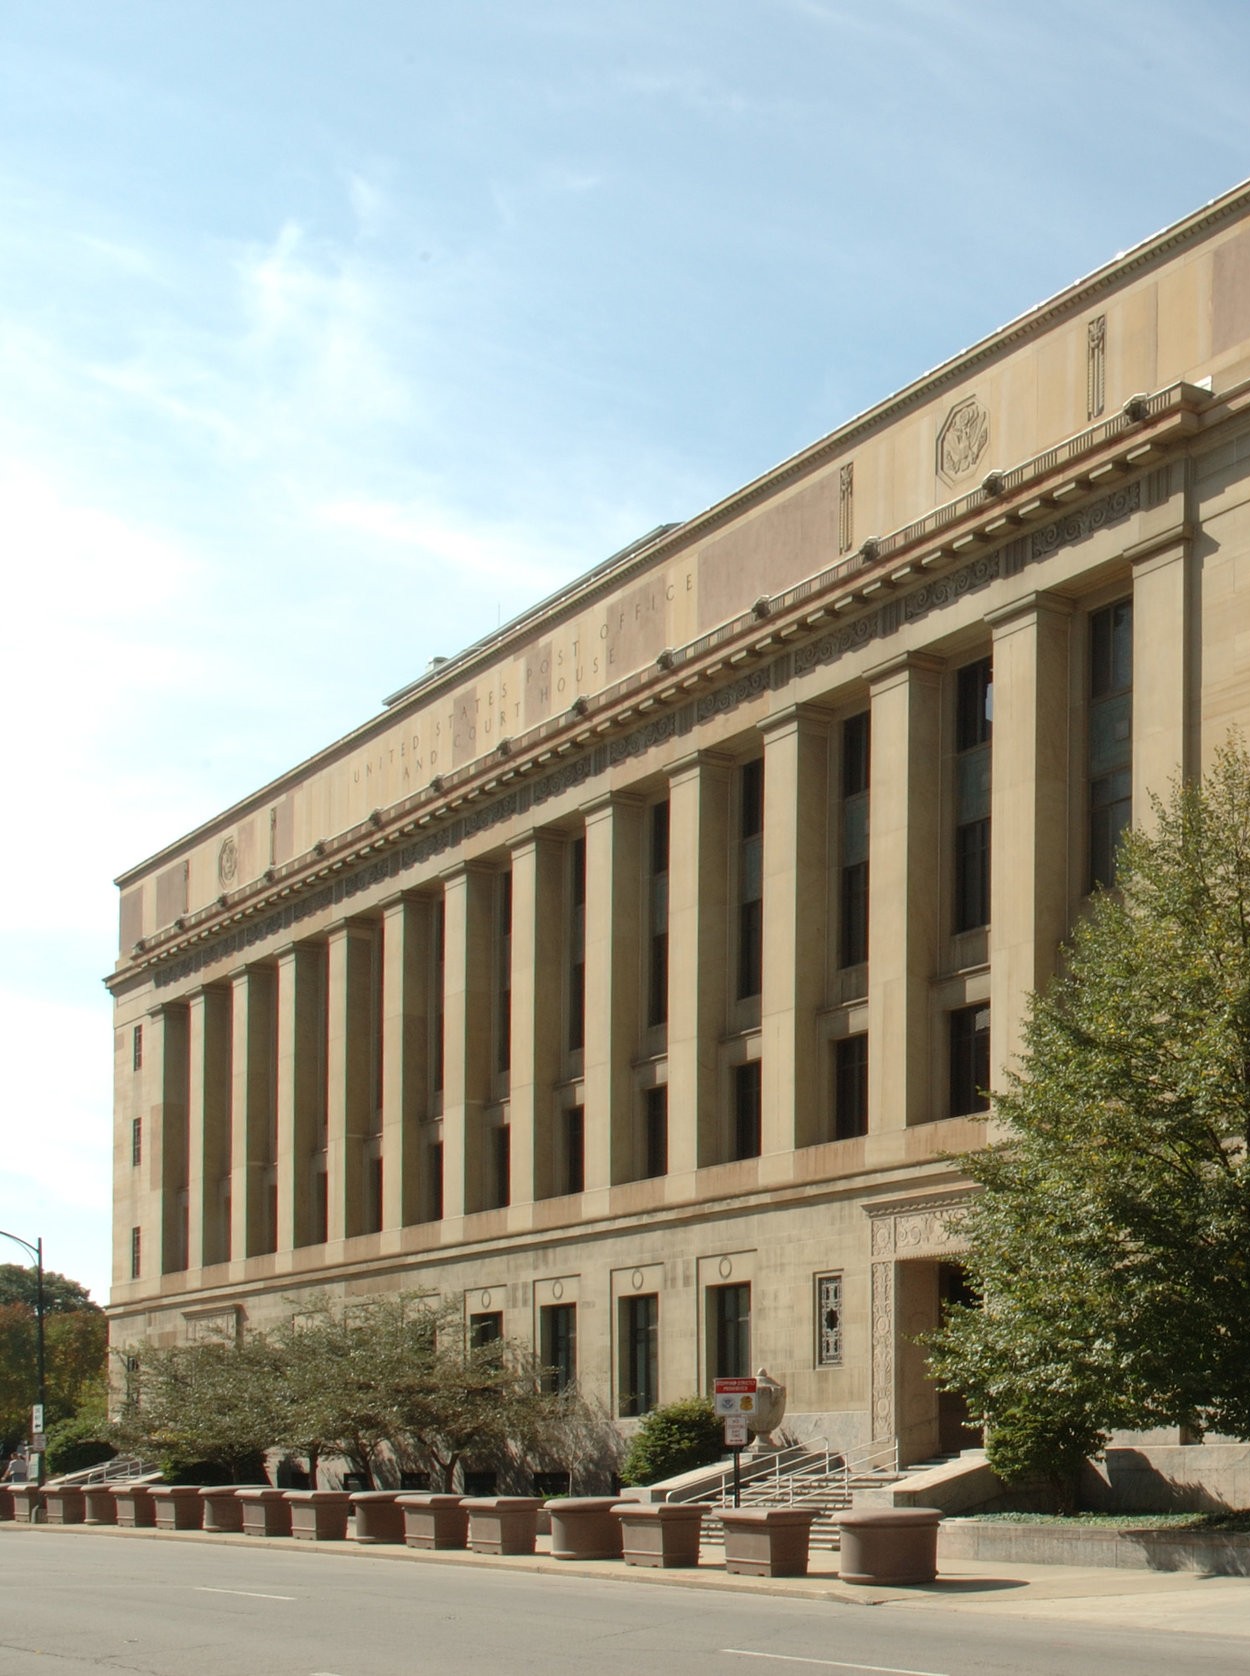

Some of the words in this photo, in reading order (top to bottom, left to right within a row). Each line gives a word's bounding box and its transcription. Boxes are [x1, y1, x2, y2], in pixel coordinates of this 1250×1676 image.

[353, 735, 419, 783] UNITED
[436, 682, 507, 737] STATES
[526, 640, 580, 684] POST
[599, 574, 692, 639] OFFICE
[402, 749, 438, 781] AND
[453, 702, 520, 748] COURT
[540, 647, 614, 704] HOUSE
